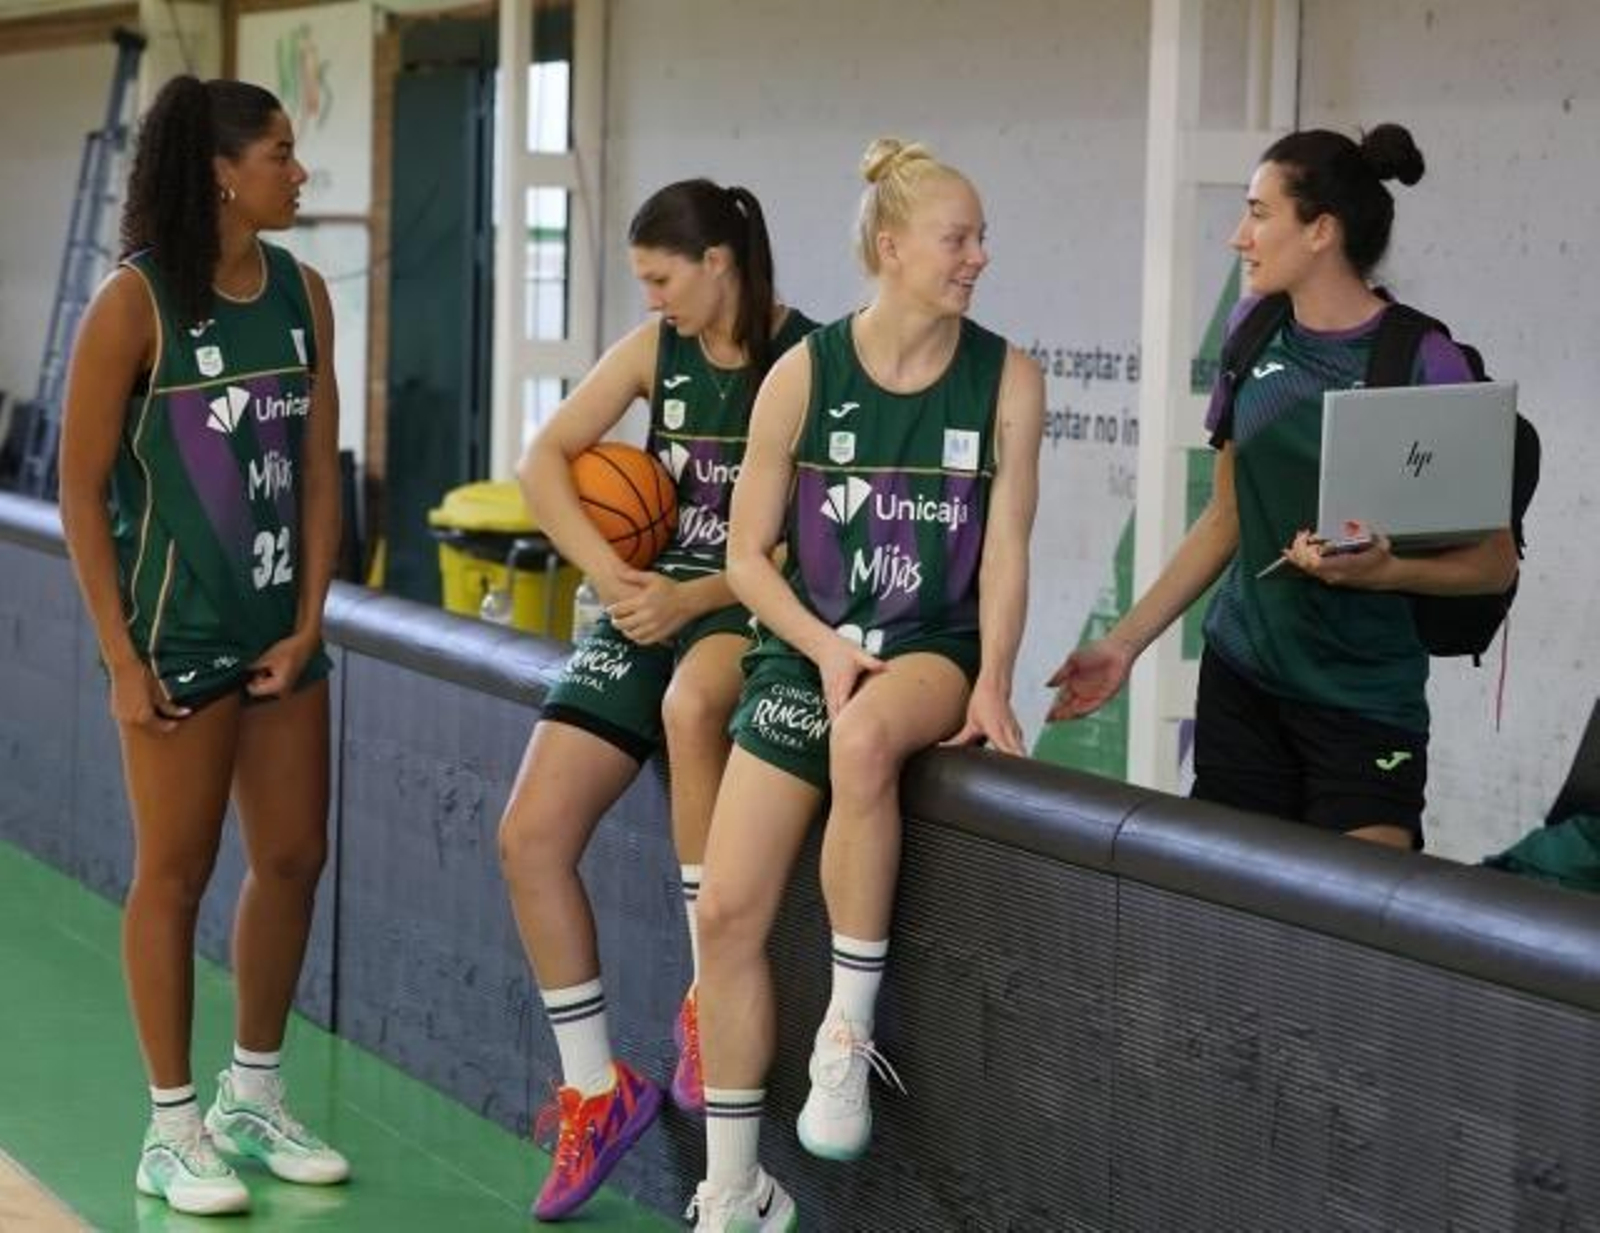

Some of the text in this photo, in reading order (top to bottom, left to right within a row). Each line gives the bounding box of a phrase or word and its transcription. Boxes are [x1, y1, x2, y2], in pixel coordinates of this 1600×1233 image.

[1094, 414, 1118, 444] no
[1406, 440, 1433, 478] hp
[875, 493, 968, 532] Unicaja
[253, 526, 293, 590] 32
[850, 544, 923, 600] Mijas
